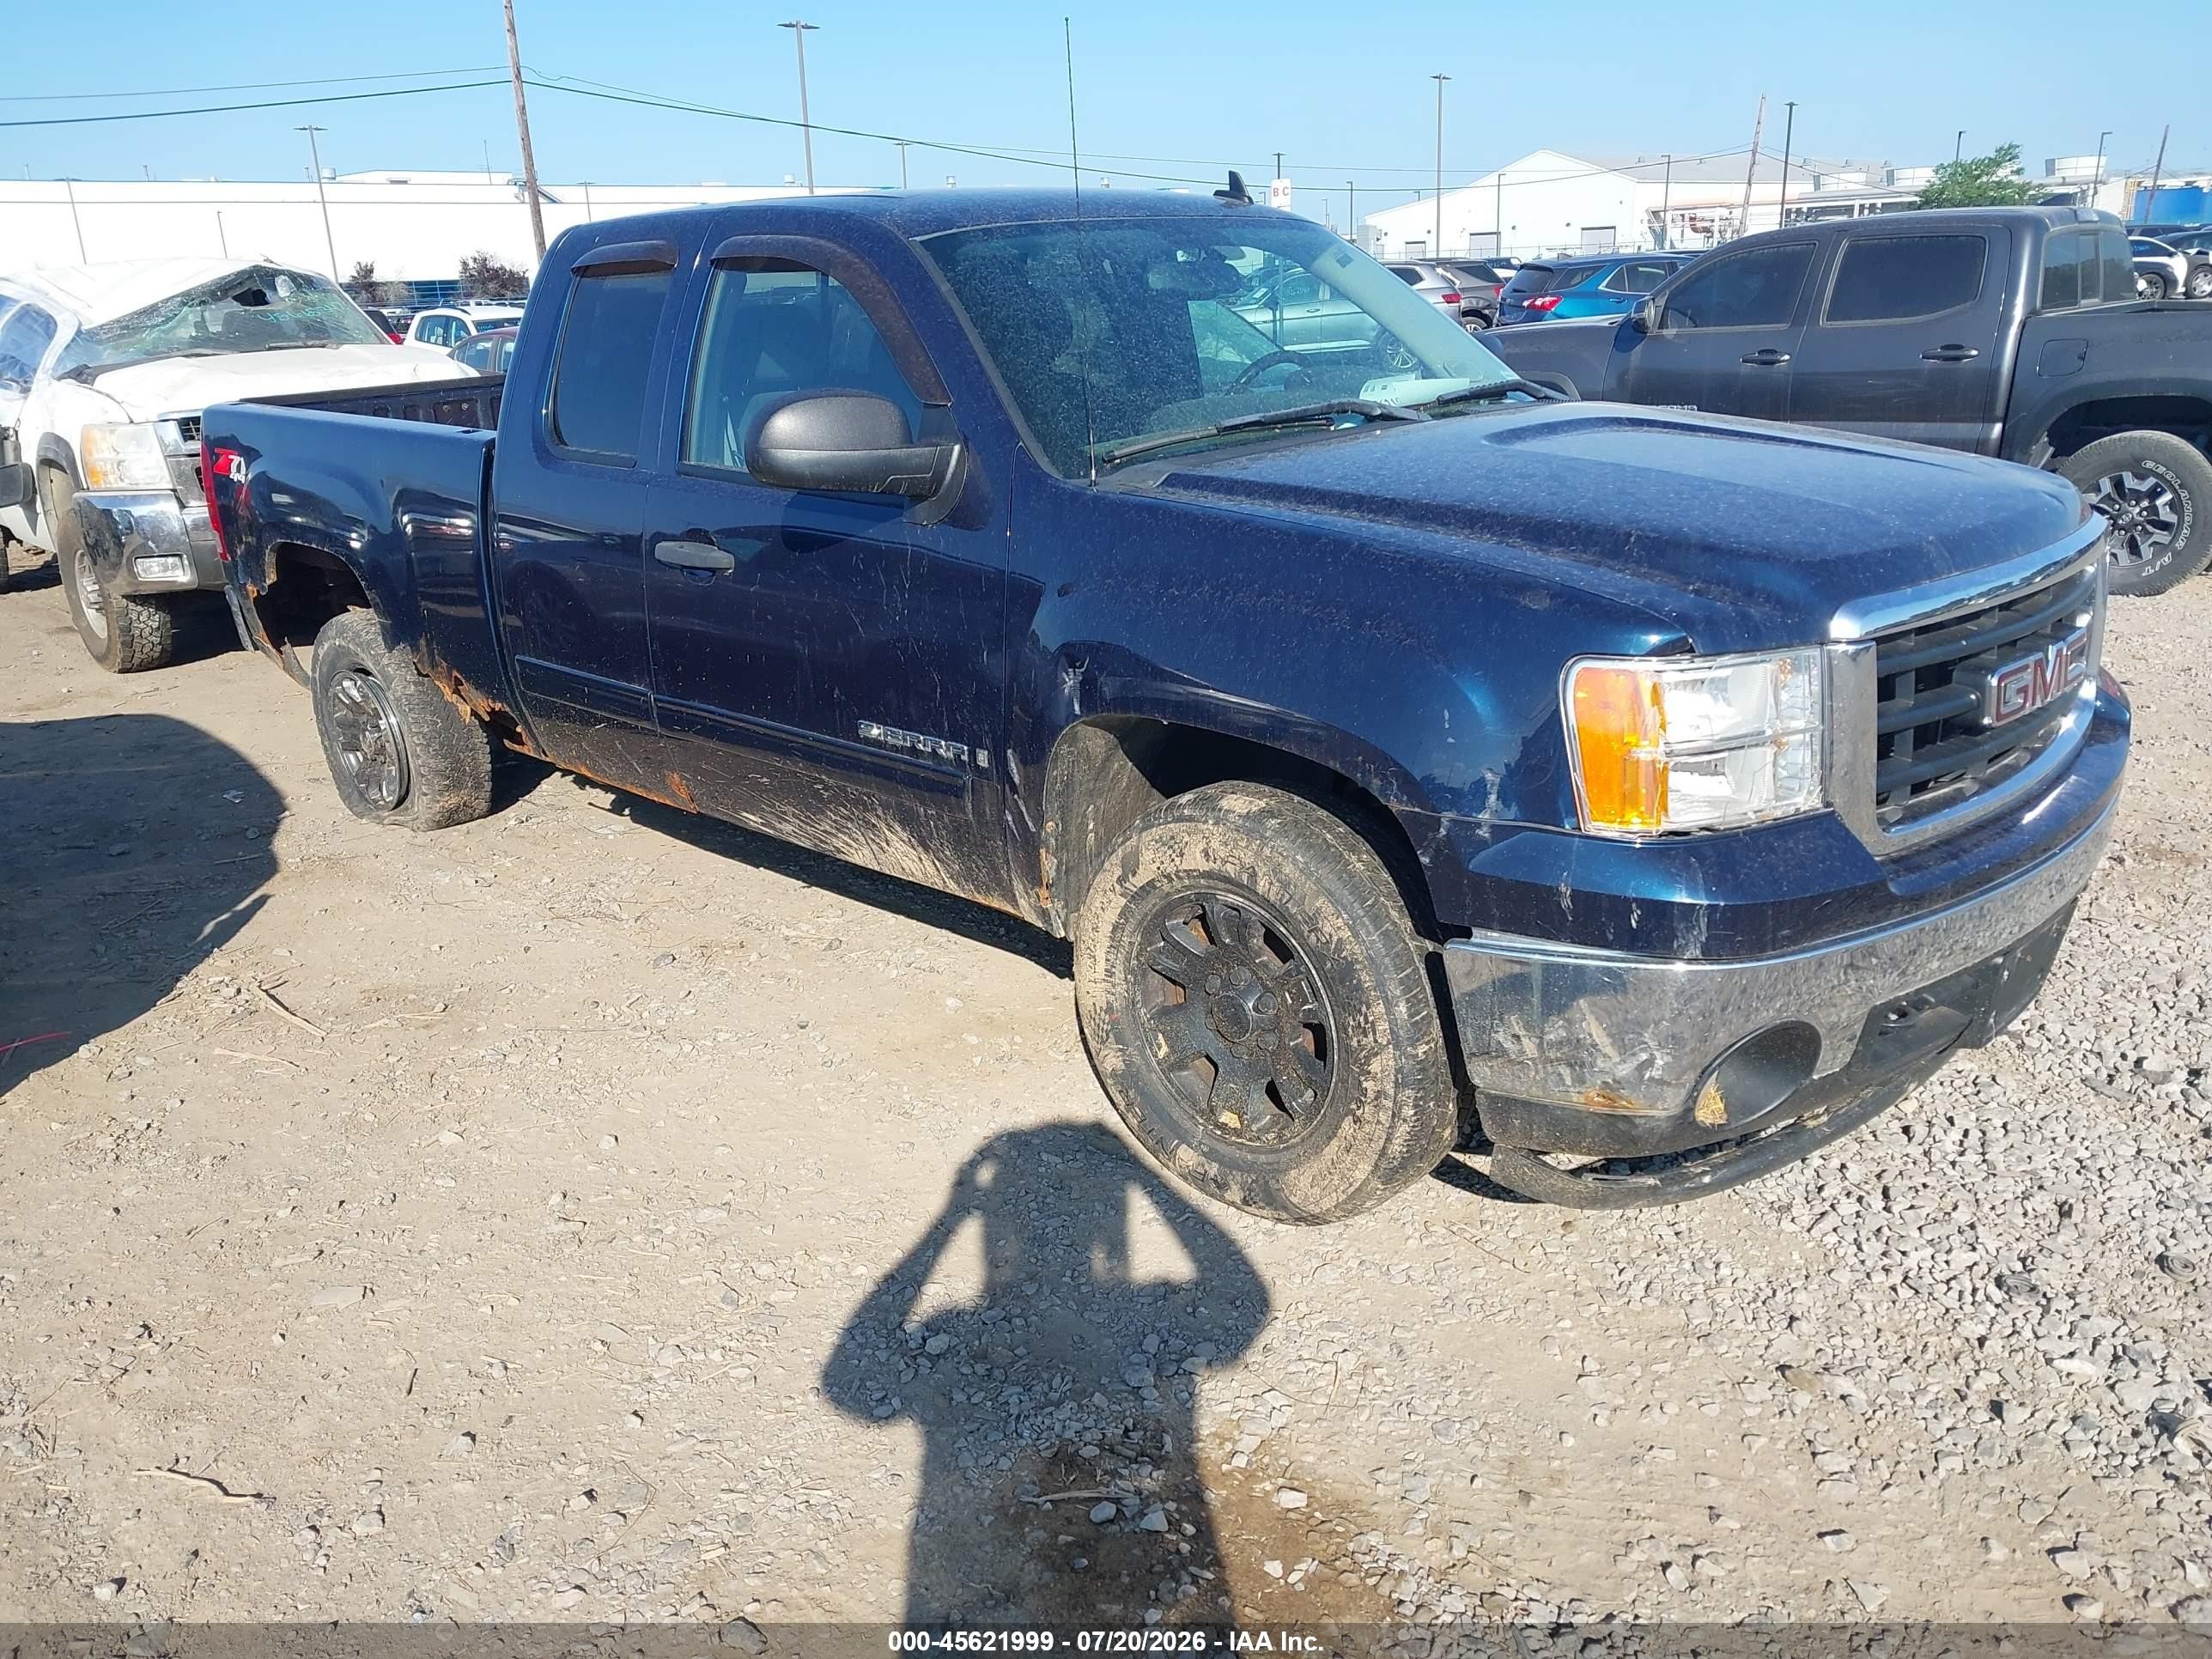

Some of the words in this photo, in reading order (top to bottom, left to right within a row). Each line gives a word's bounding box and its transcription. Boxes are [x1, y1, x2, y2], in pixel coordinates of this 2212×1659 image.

[2141, 459, 2193, 550] GEOLANDAR
[2141, 551, 2172, 577] A/T
[1987, 627, 2087, 727] GMC
[857, 720, 969, 762] SIERRA
